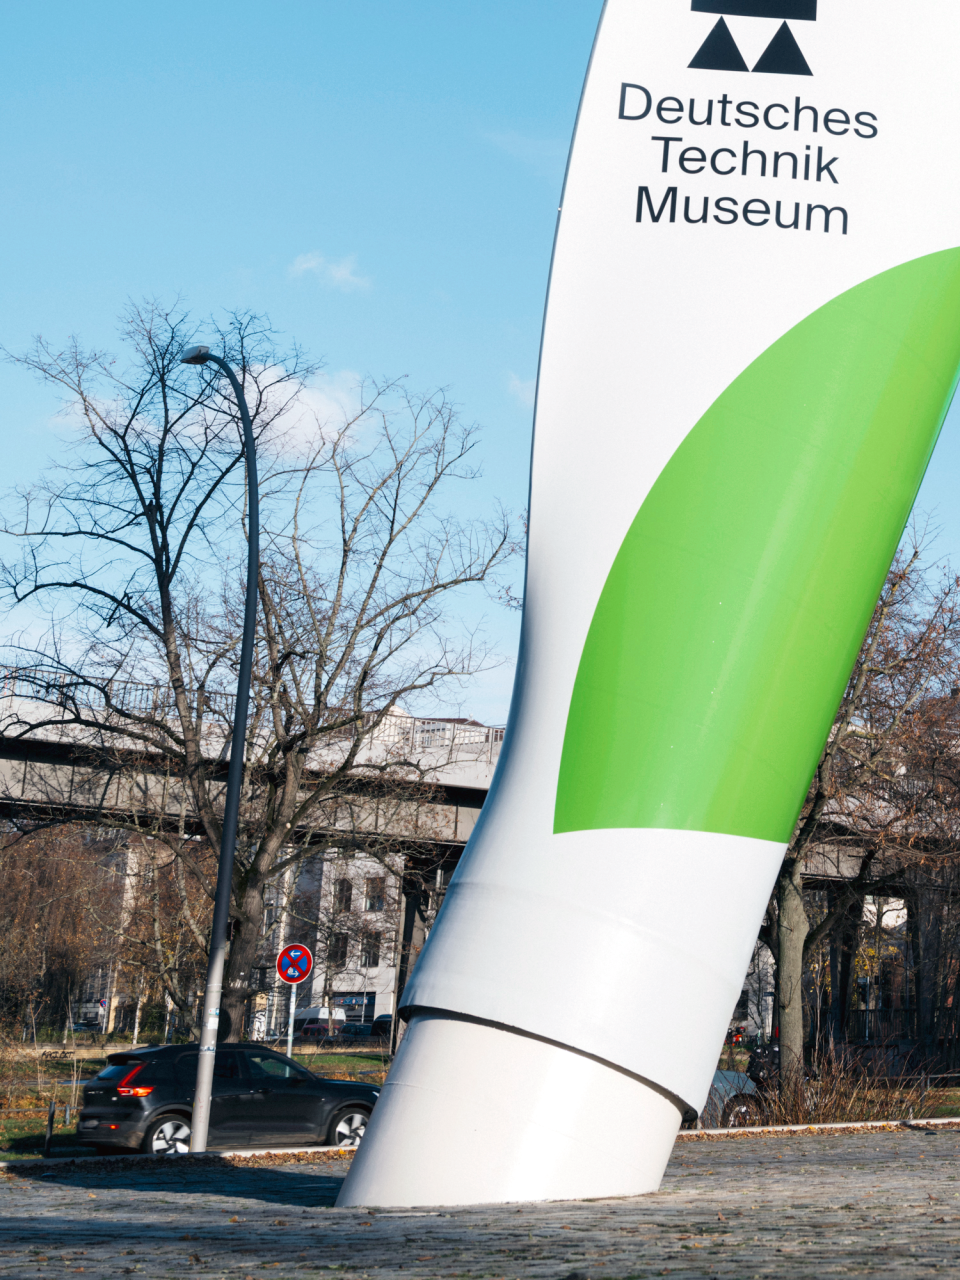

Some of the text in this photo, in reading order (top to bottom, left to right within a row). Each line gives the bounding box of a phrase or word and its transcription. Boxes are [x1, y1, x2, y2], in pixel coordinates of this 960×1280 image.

[617, 82, 879, 139] Deutsches
[651, 136, 840, 184] Technik
[635, 185, 849, 235] Museum
